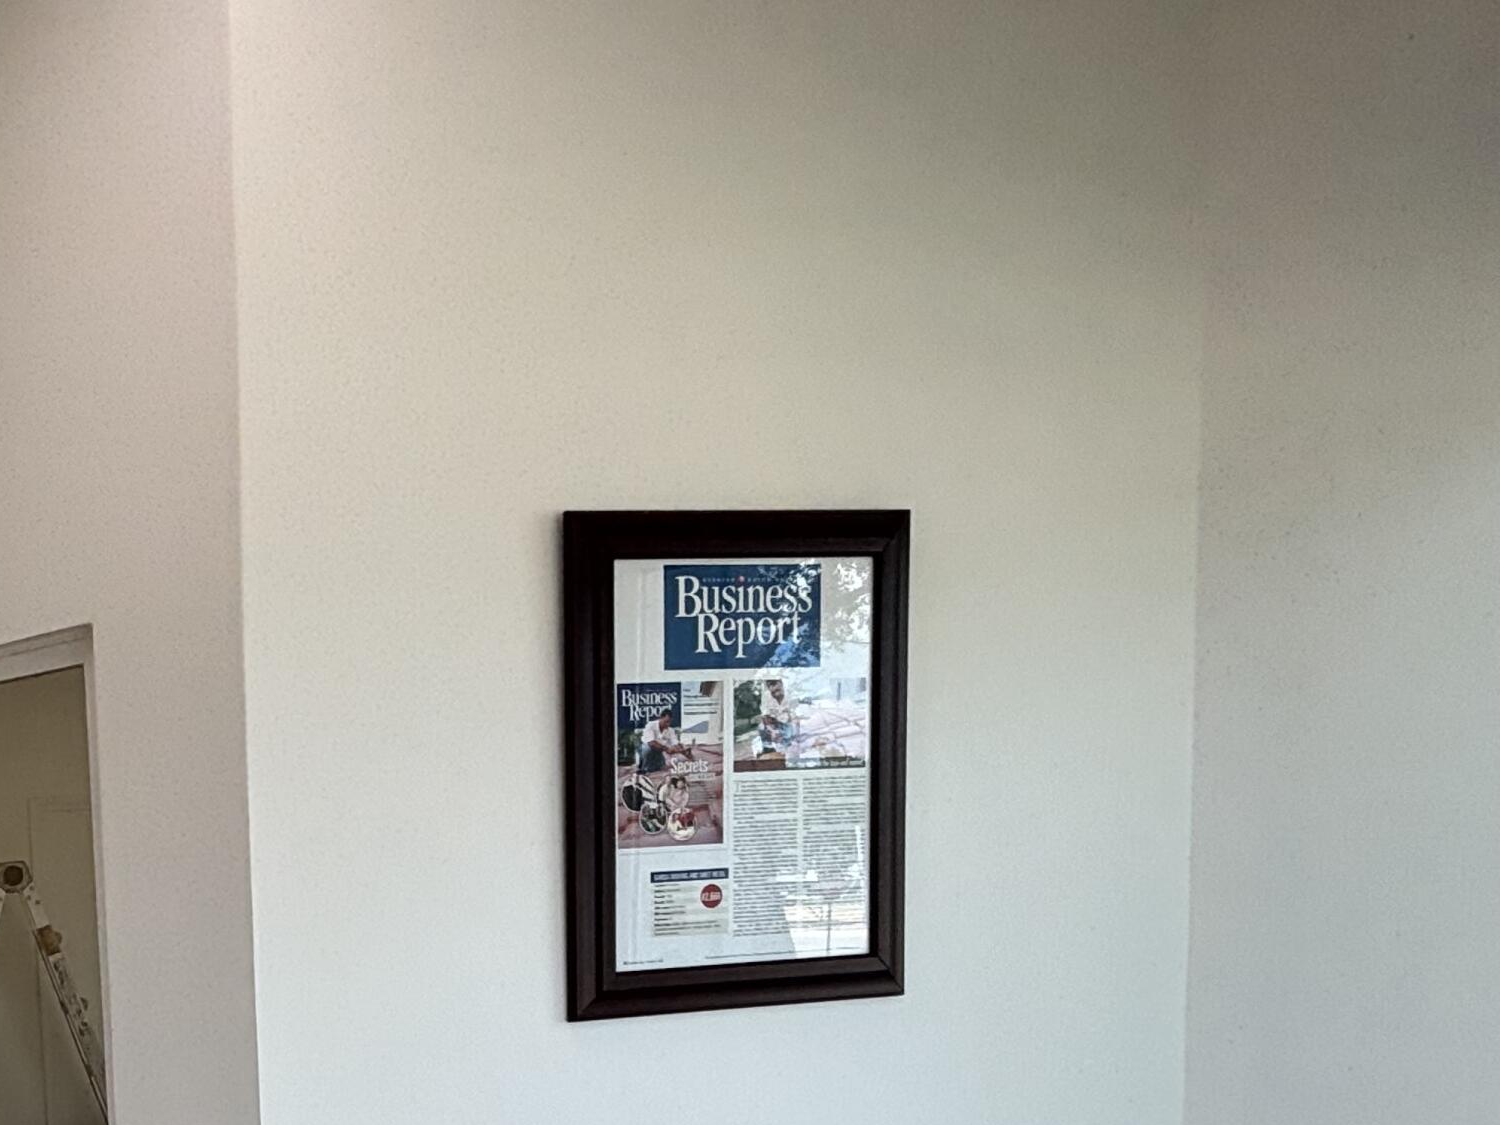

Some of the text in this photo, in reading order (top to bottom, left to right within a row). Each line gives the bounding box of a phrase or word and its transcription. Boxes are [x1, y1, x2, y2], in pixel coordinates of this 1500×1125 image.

[674, 576, 812, 618] Business
[695, 612, 801, 658] Report
[622, 689, 677, 707] Business
